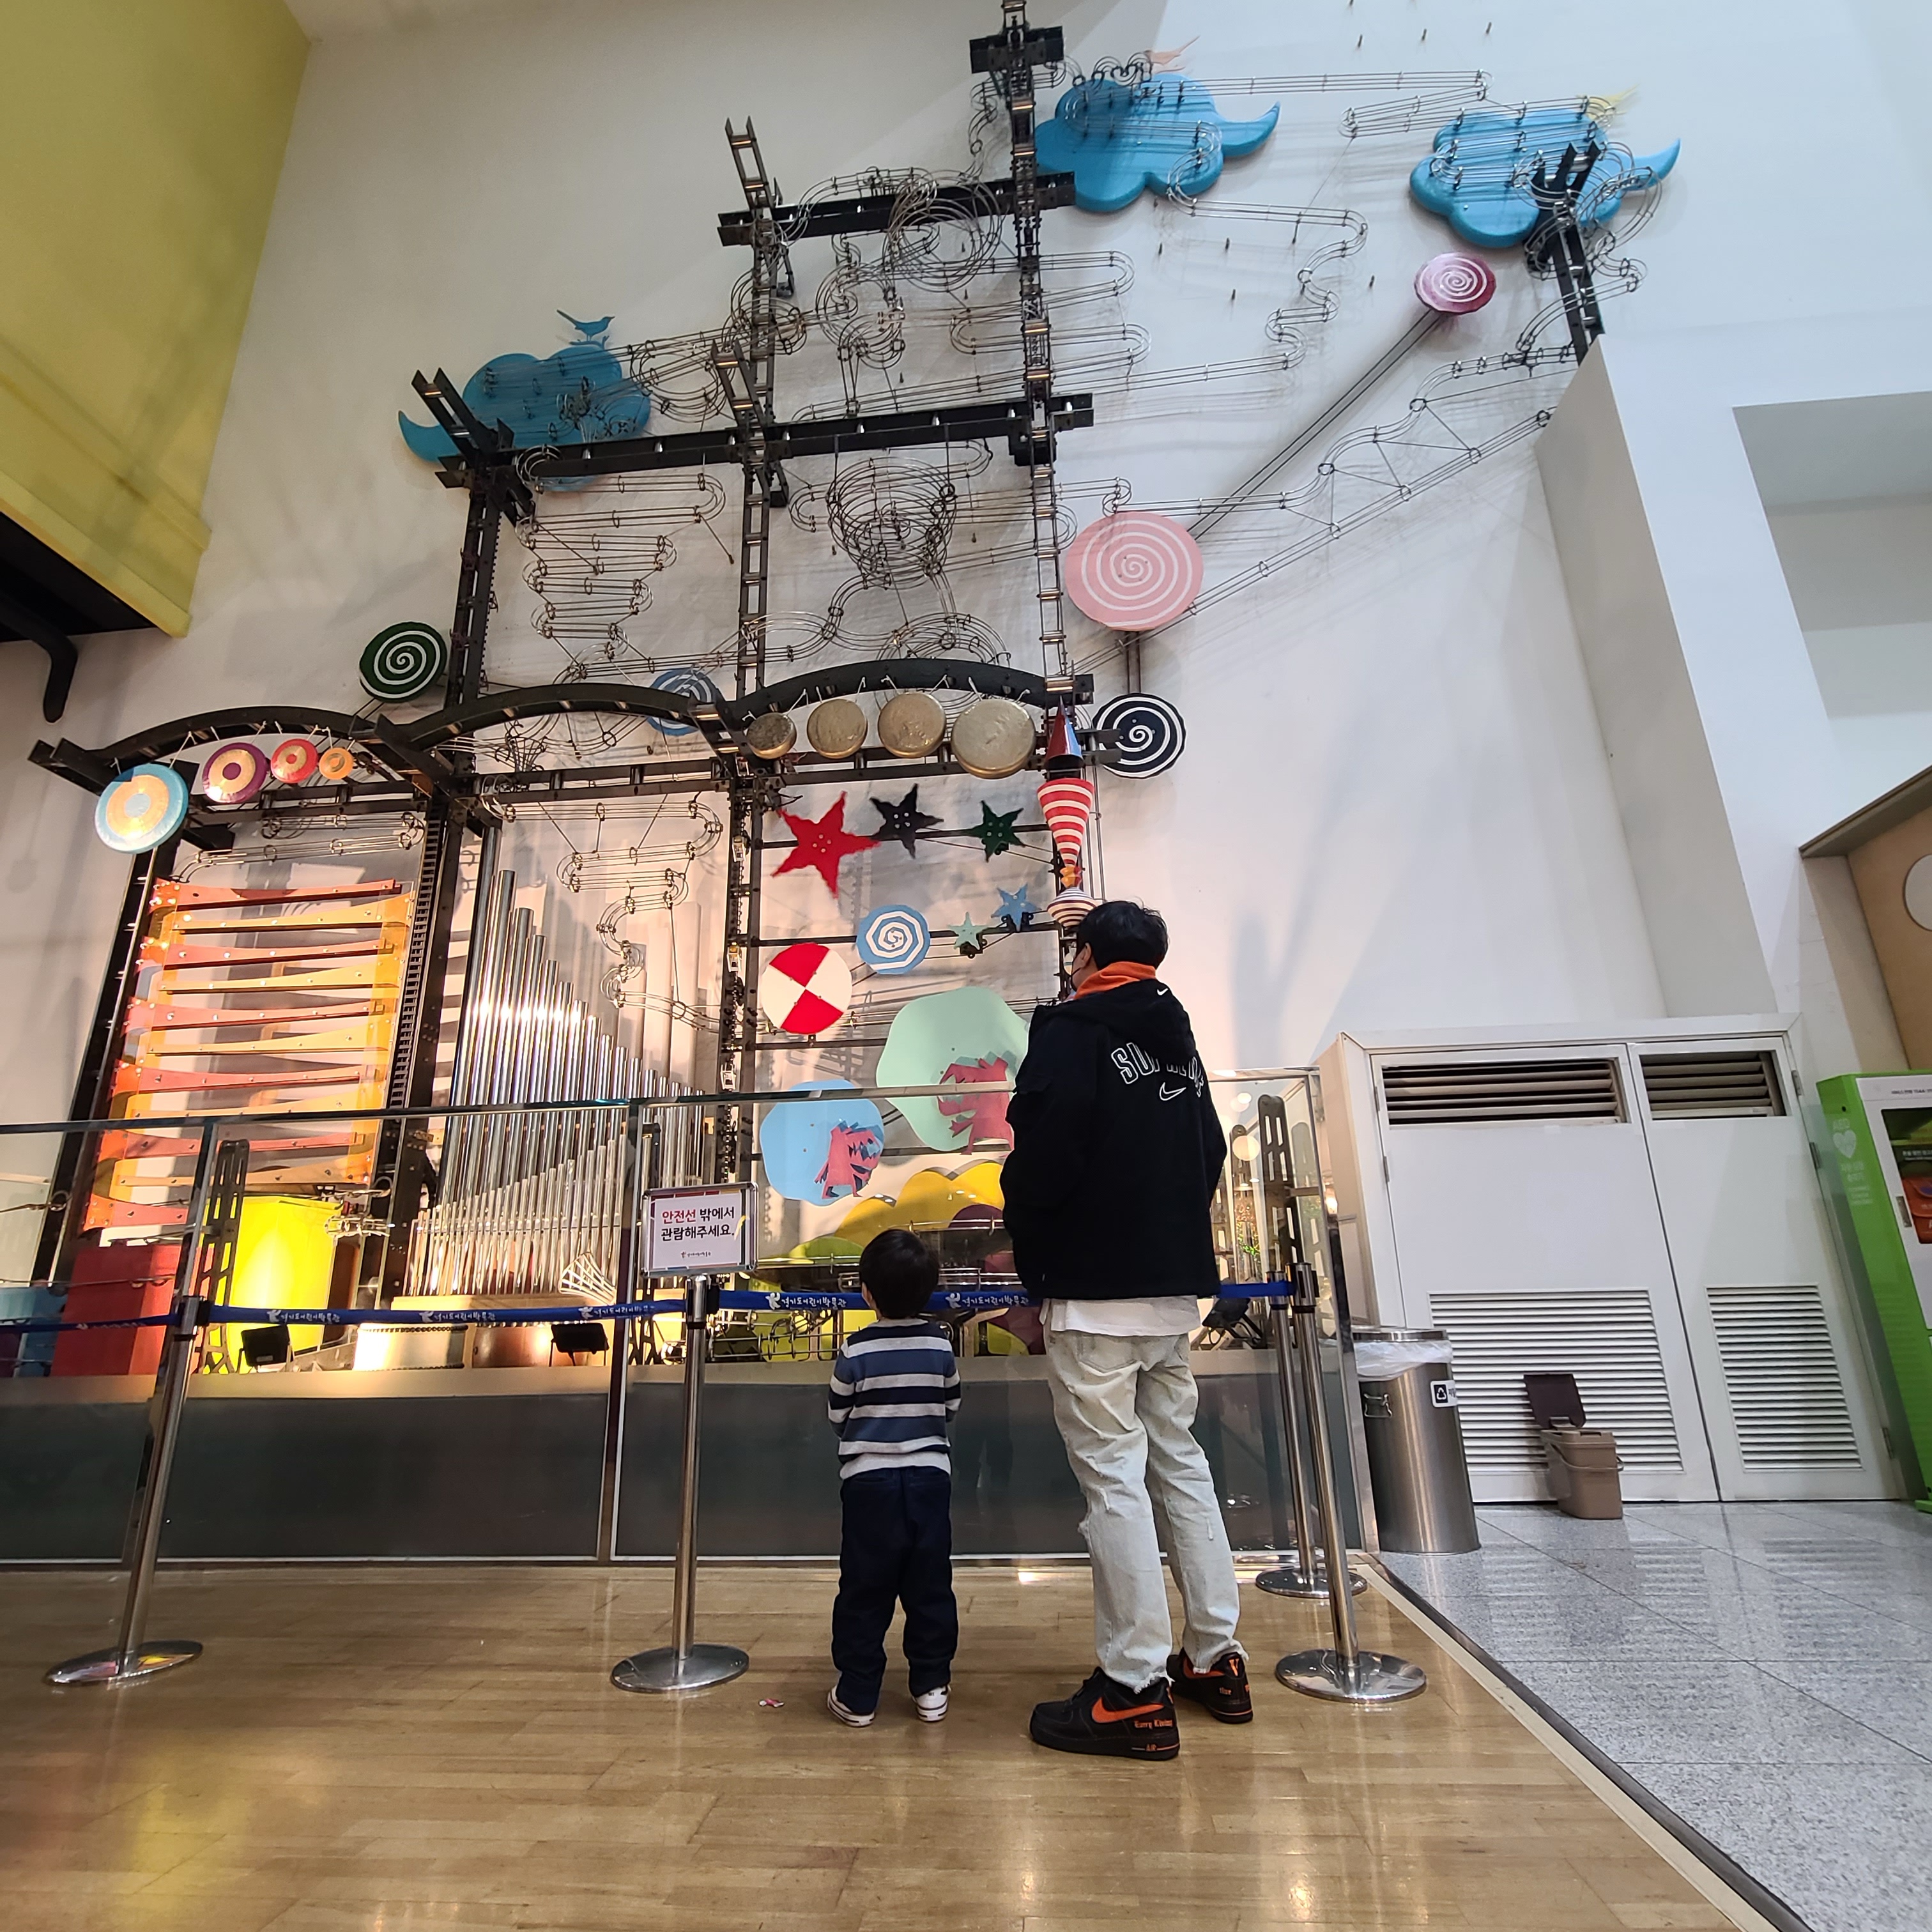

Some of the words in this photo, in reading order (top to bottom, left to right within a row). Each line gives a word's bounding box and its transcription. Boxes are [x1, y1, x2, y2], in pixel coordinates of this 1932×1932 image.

[662, 1209, 696, 1223] 안전선
[700, 1206, 735, 1222] 밖에서
[661, 1224, 735, 1241] 관람해주세요.
[781, 1296, 847, 1310] 경기도어린이박물관
[594, 1305, 656, 1317] 경기도어린이박
[1146, 1744, 1157, 1752] AIR
